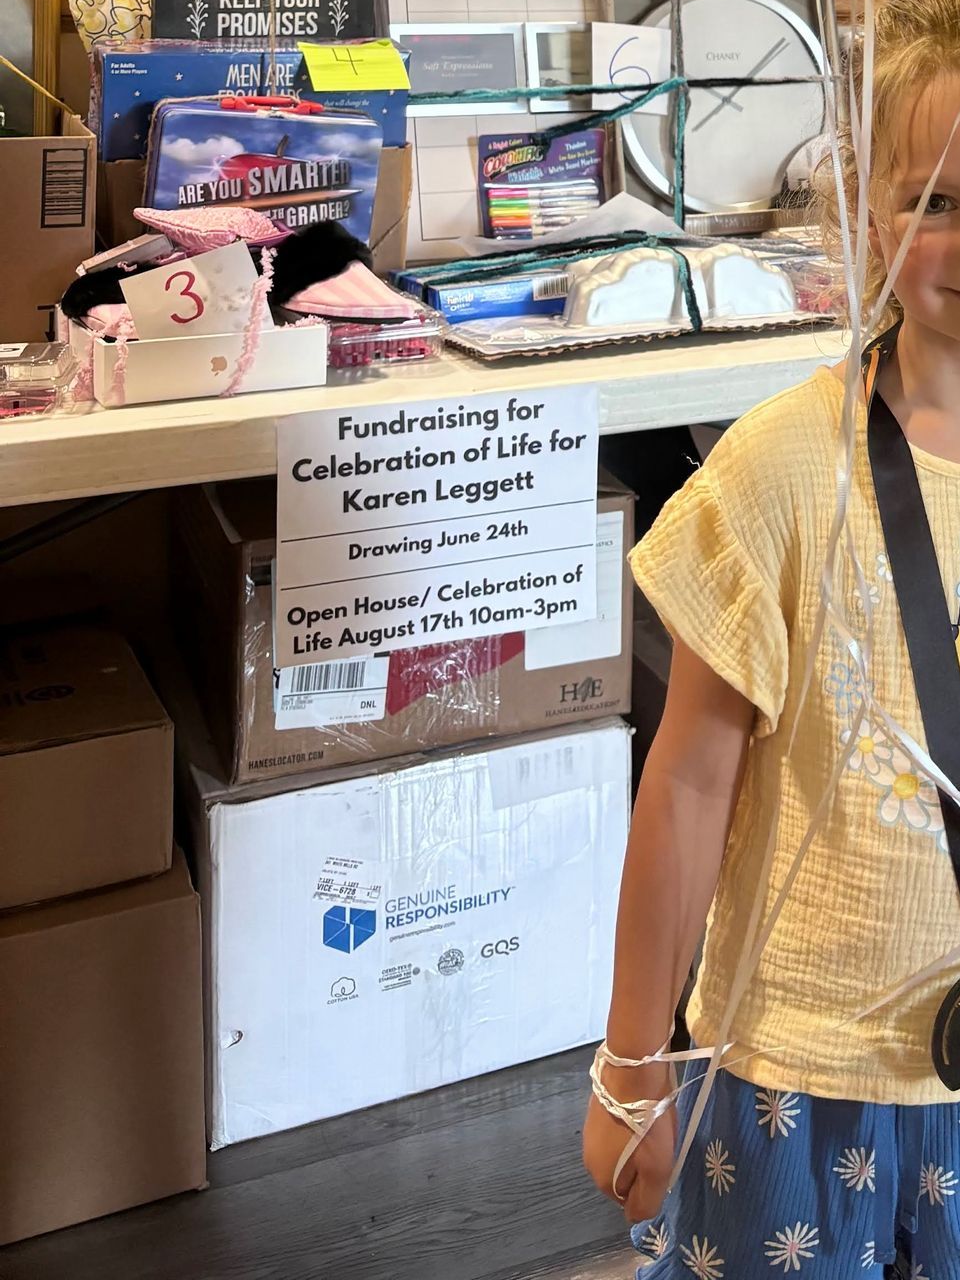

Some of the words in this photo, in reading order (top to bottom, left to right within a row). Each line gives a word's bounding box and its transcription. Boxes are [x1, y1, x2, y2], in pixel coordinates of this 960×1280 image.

[217, 11, 318, 36] PROMISES
[226, 64, 261, 87] MEN
[265, 64, 294, 87] ARE
[330, 48, 364, 76] 4
[608, 36, 652, 101] 6
[705, 51, 741, 62] CHANEY
[178, 183, 204, 205] ARE
[208, 177, 241, 200] YOU
[248, 160, 352, 196] SMARTER
[286, 200, 350, 228] GRADER?
[164, 270, 205, 324] 3
[338, 404, 499, 440] Fundraising
[507, 398, 544, 421] for
[292, 445, 456, 482] Celebration
[463, 437, 491, 461] of
[497, 433, 542, 458] Life
[550, 429, 586, 451] for
[343, 489, 427, 513] Karen
[435, 471, 534, 504] Leggett
[348, 537, 432, 560] Drawing
[437, 531, 480, 548] June
[486, 520, 528, 540] 24th
[286, 604, 347, 628] Open
[353, 586, 431, 616] House/
[437, 571, 557, 602] Celebration
[563, 564, 583, 583] of
[293, 632, 333, 655] Life
[338, 619, 415, 647] August
[420, 613, 463, 634] 17th
[469, 598, 578, 626] 10am-3pm
[360, 700, 377, 710] DNL
[248, 750, 324, 771] HANESLOCATOR.COM
[384, 885, 457, 914] GENUINE
[385, 887, 511, 930] RESPONSIBILITY
[480, 936, 520, 959] GQS
